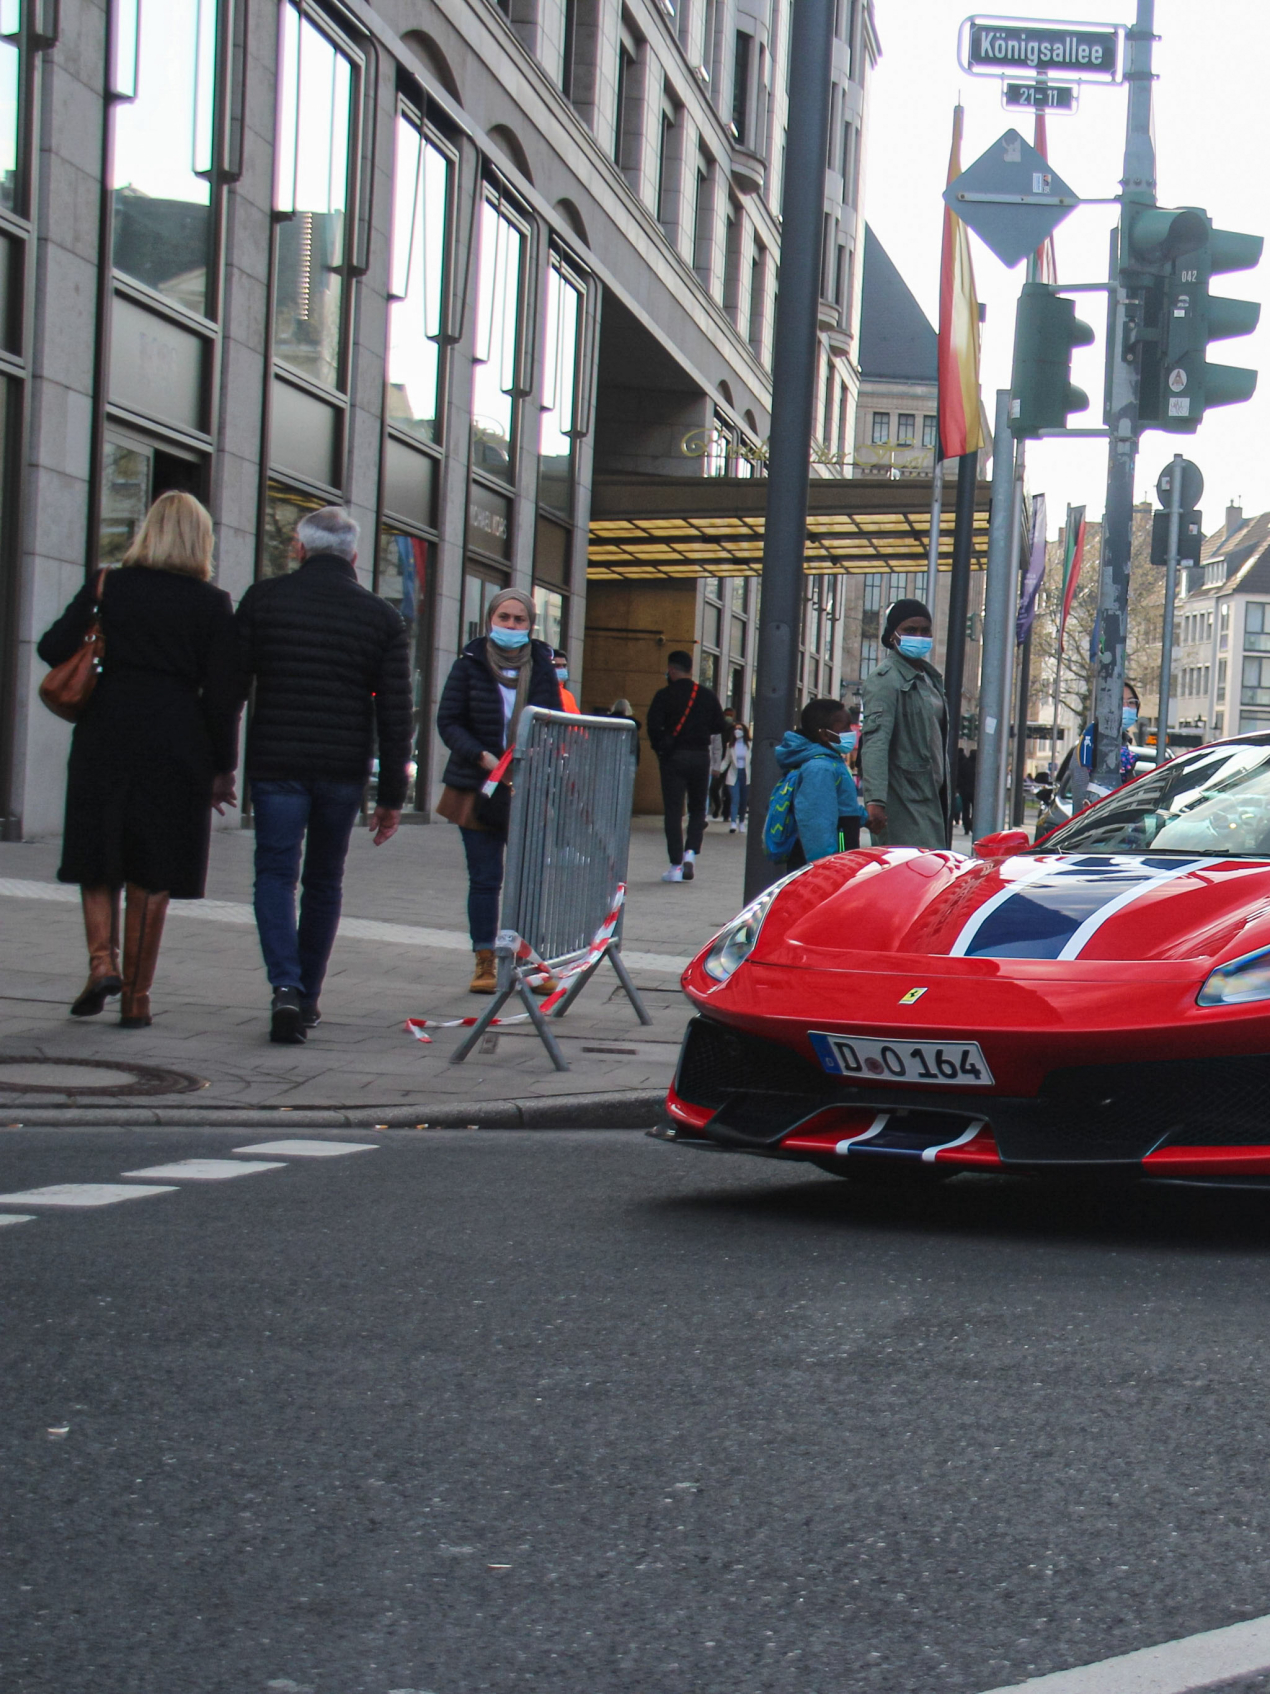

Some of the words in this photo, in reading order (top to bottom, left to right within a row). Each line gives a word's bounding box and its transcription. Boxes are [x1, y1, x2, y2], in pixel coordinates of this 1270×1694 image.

[980, 31, 1103, 66] Königsallee
[1047, 90, 1058, 107] 11
[1181, 270, 1197, 283] 042
[834, 1041, 863, 1072] D
[910, 1048, 982, 1080] 164
